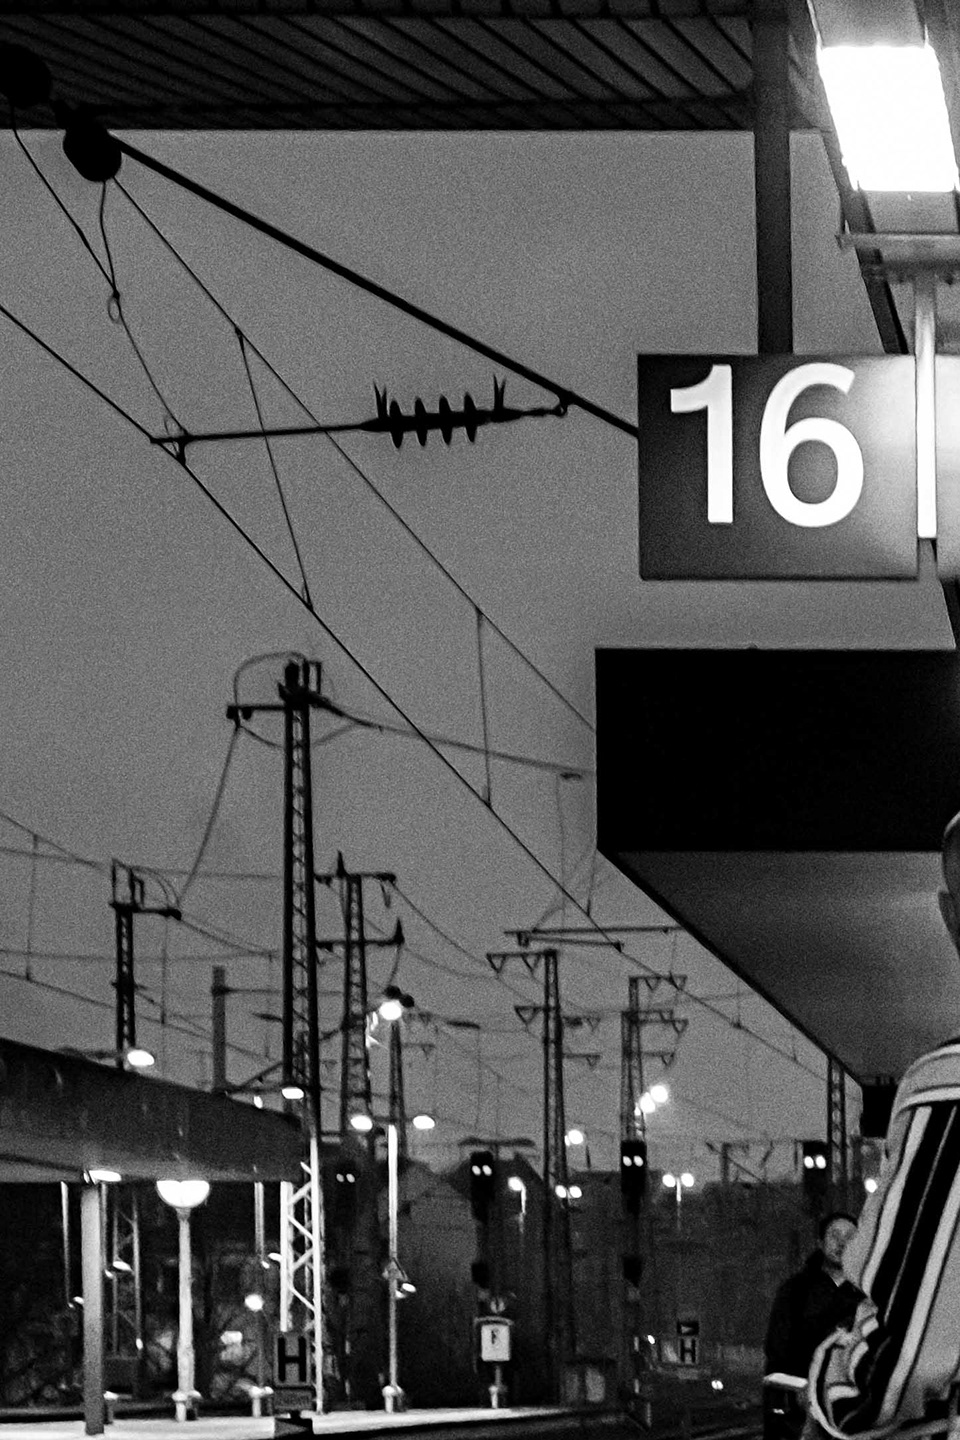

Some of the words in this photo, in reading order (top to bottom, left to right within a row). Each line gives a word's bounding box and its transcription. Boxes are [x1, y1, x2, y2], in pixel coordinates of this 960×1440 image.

[669, 361, 865, 528] 16
[277, 1335, 307, 1382] H
[680, 1338, 697, 1363] H
